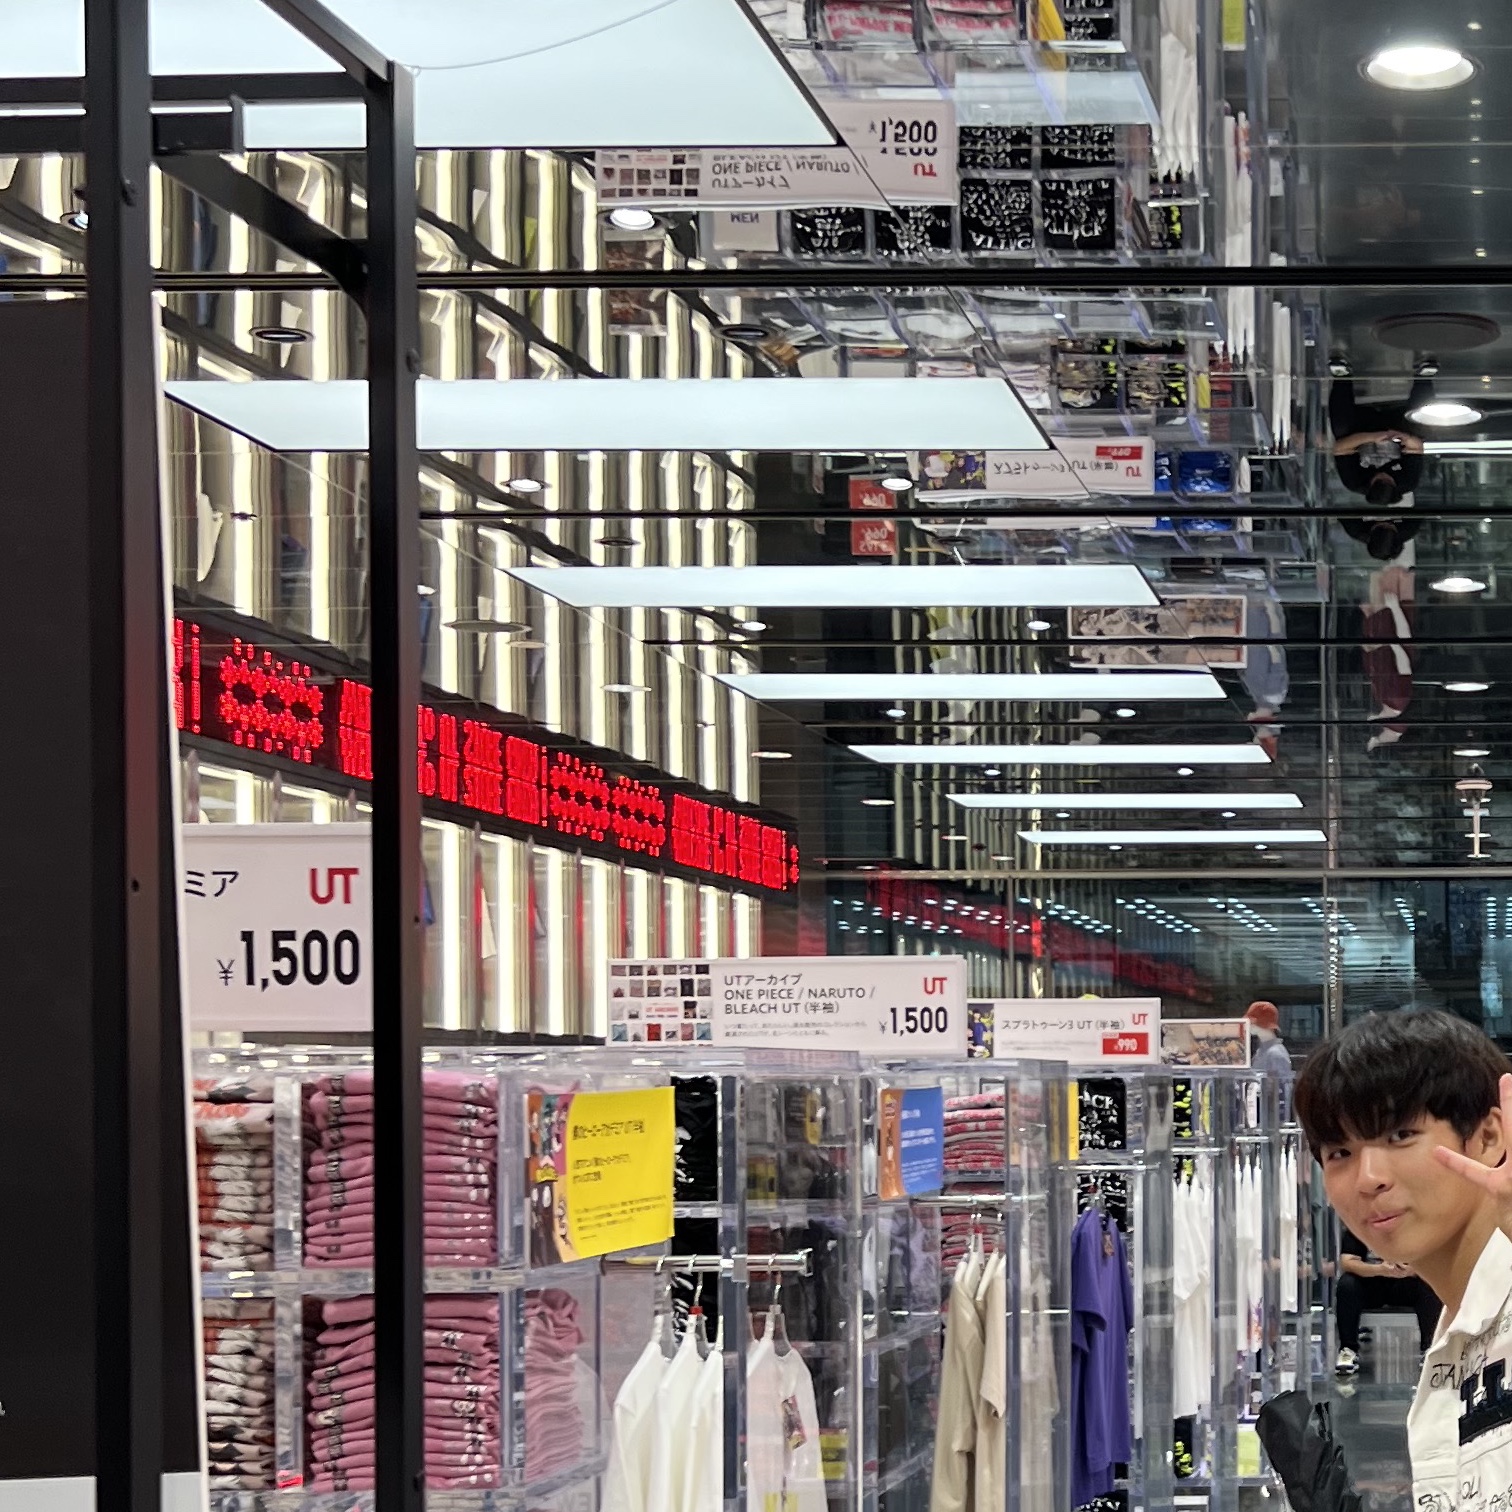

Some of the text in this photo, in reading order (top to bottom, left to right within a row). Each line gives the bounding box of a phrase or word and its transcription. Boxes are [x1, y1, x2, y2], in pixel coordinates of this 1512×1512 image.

[309, 867, 360, 905] UT
[217, 929, 360, 993] ¥1,500
[724, 989, 753, 1000] ONE
[757, 988, 794, 1000] PIECE
[808, 987, 866, 999] NARUTO
[923, 976, 948, 995] UT
[724, 1003, 778, 1015] BLEACH
[782, 1003, 800, 1014] UT
[1132, 1013, 1148, 1026] UT
